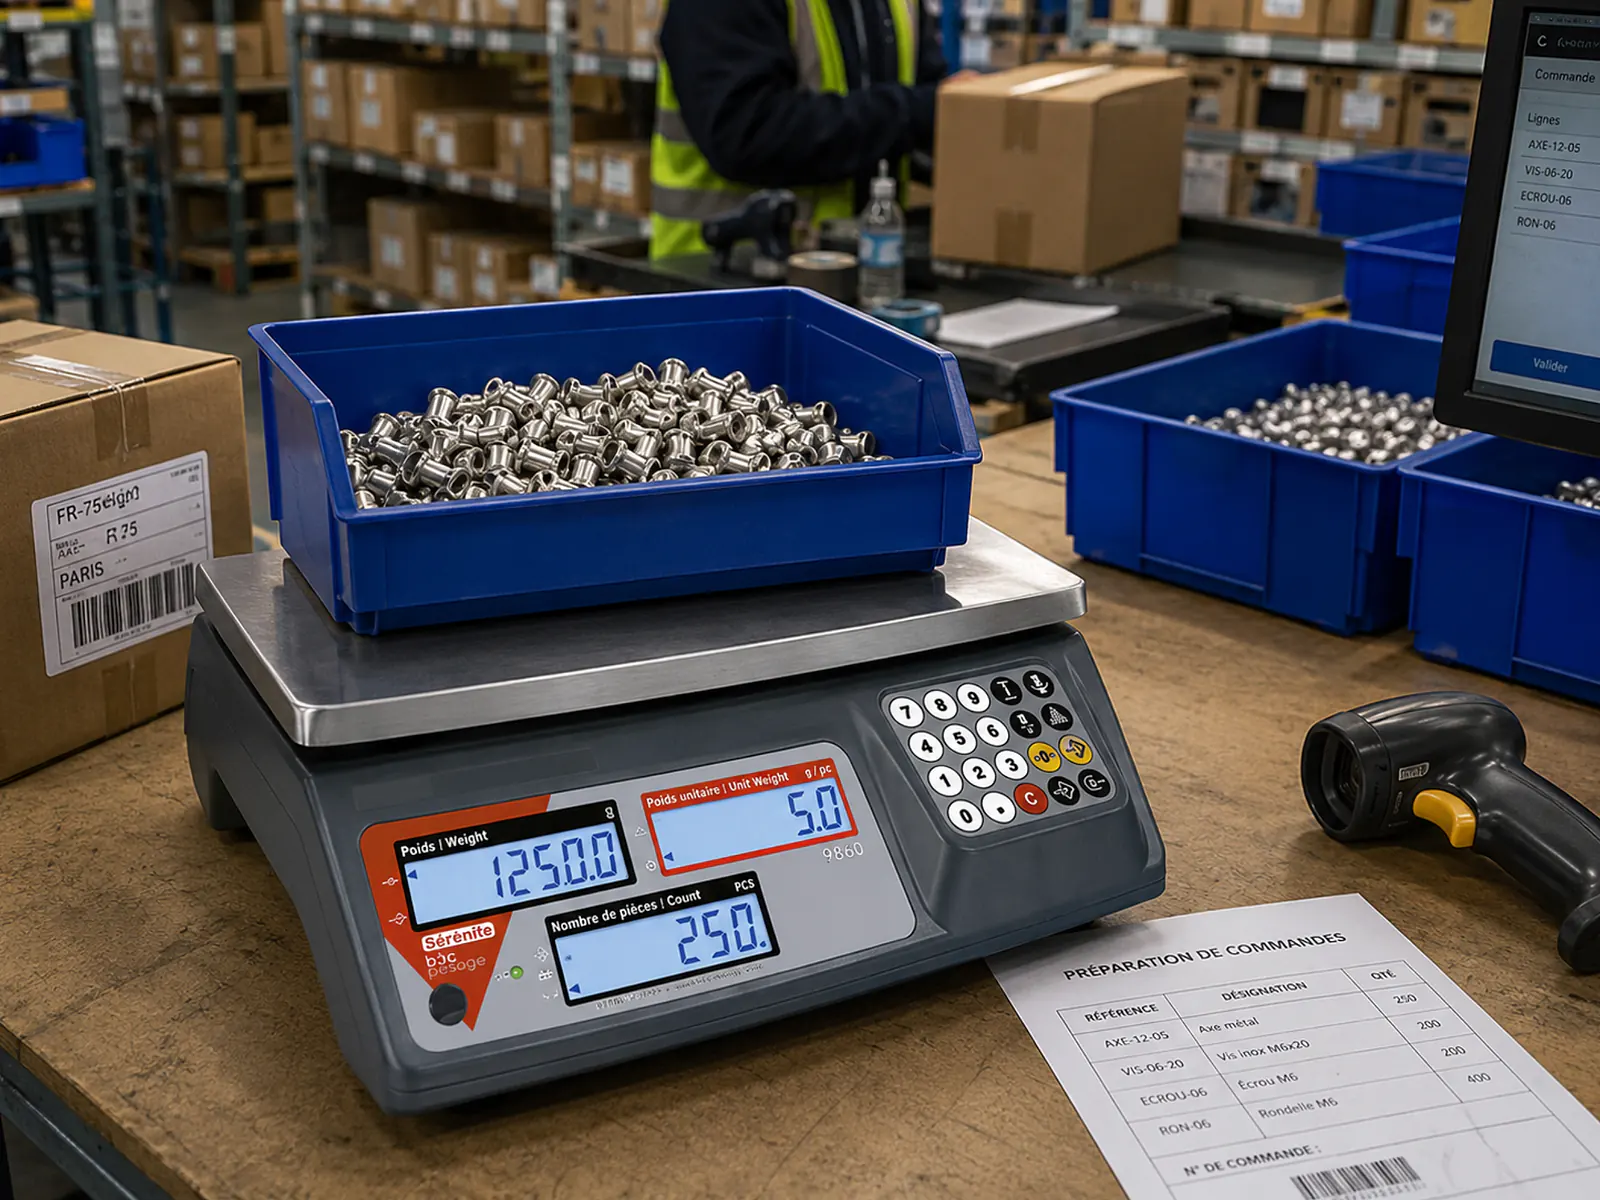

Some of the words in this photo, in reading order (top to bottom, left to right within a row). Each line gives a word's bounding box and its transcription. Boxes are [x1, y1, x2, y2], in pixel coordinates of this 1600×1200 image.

[1535, 68, 1595, 83] Commande
[1528, 112, 1560, 126] Lignes
[1528, 139, 1580, 153] AXE-12-05
[1525, 165, 1573, 180] VIS-06-20
[1520, 190, 1572, 206] ECROU-06
[1516, 216, 1556, 230] RON-06
[1533, 358, 1568, 373] Valider
[60, 561, 104, 590] PARIS
[900, 705, 911, 720] 7
[934, 698, 948, 712] 8
[968, 691, 980, 705] 9
[922, 739, 933, 754] 4
[954, 732, 966, 746] 5
[987, 724, 1000, 738] 6
[939, 774, 951, 788] 1
[972, 766, 987, 780] 2
[1005, 758, 1018, 772] 3
[646, 794, 678, 808] Poids
[680, 784, 721, 802] unitaire
[729, 778, 751, 792] Unit
[752, 772, 790, 787] Weight
[788, 784, 842, 836] 5.0
[960, 808, 973, 824] 0
[1024, 792, 1038, 806] C
[401, 840, 436, 858] Poids
[445, 830, 488, 848] Weight
[822, 842, 864, 863] 9860
[734, 878, 756, 892] PCS
[551, 914, 600, 933] Nombre
[602, 906, 617, 920] de
[620, 900, 658, 920] pièces
[666, 890, 702, 906] Count
[1063, 951, 1194, 980] PRÉPARATION
[1196, 942, 1222, 960] DE
[1226, 932, 1347, 957] COMMANDES
[1084, 1004, 1159, 1022] RÉFÉRENCE
[1221, 981, 1308, 1001] DÉSIGNATION
[1370, 969, 1396, 980] QTÉ
[1104, 1030, 1170, 1048] AXE-12-05
[1198, 1022, 1222, 1034] Axe
[1230, 1016, 1260, 1030] métal
[1393, 994, 1418, 1004] 250
[1120, 1059, 1184, 1077] VIS-06-20
[1216, 1050, 1237, 1062] Vis
[1240, 1046, 1266, 1058] inox
[1267, 1040, 1310, 1054] M6x20
[1416, 1019, 1442, 1030] 200
[1140, 1088, 1208, 1106] ECROU-06
[1238, 1078, 1274, 1092] Écrou
[1276, 1072, 1299, 1086] M6
[1440, 1045, 1466, 1057] 200
[1158, 1120, 1212, 1136] RON-06
[1258, 1101, 1315, 1120] Rondelle
[1316, 1096, 1338, 1110] M6
[1466, 1072, 1491, 1084] 400
[1184, 1164, 1200, 1177] N°
[1204, 1160, 1226, 1173] DE
[1227, 1144, 1314, 1170] COMMANDE
